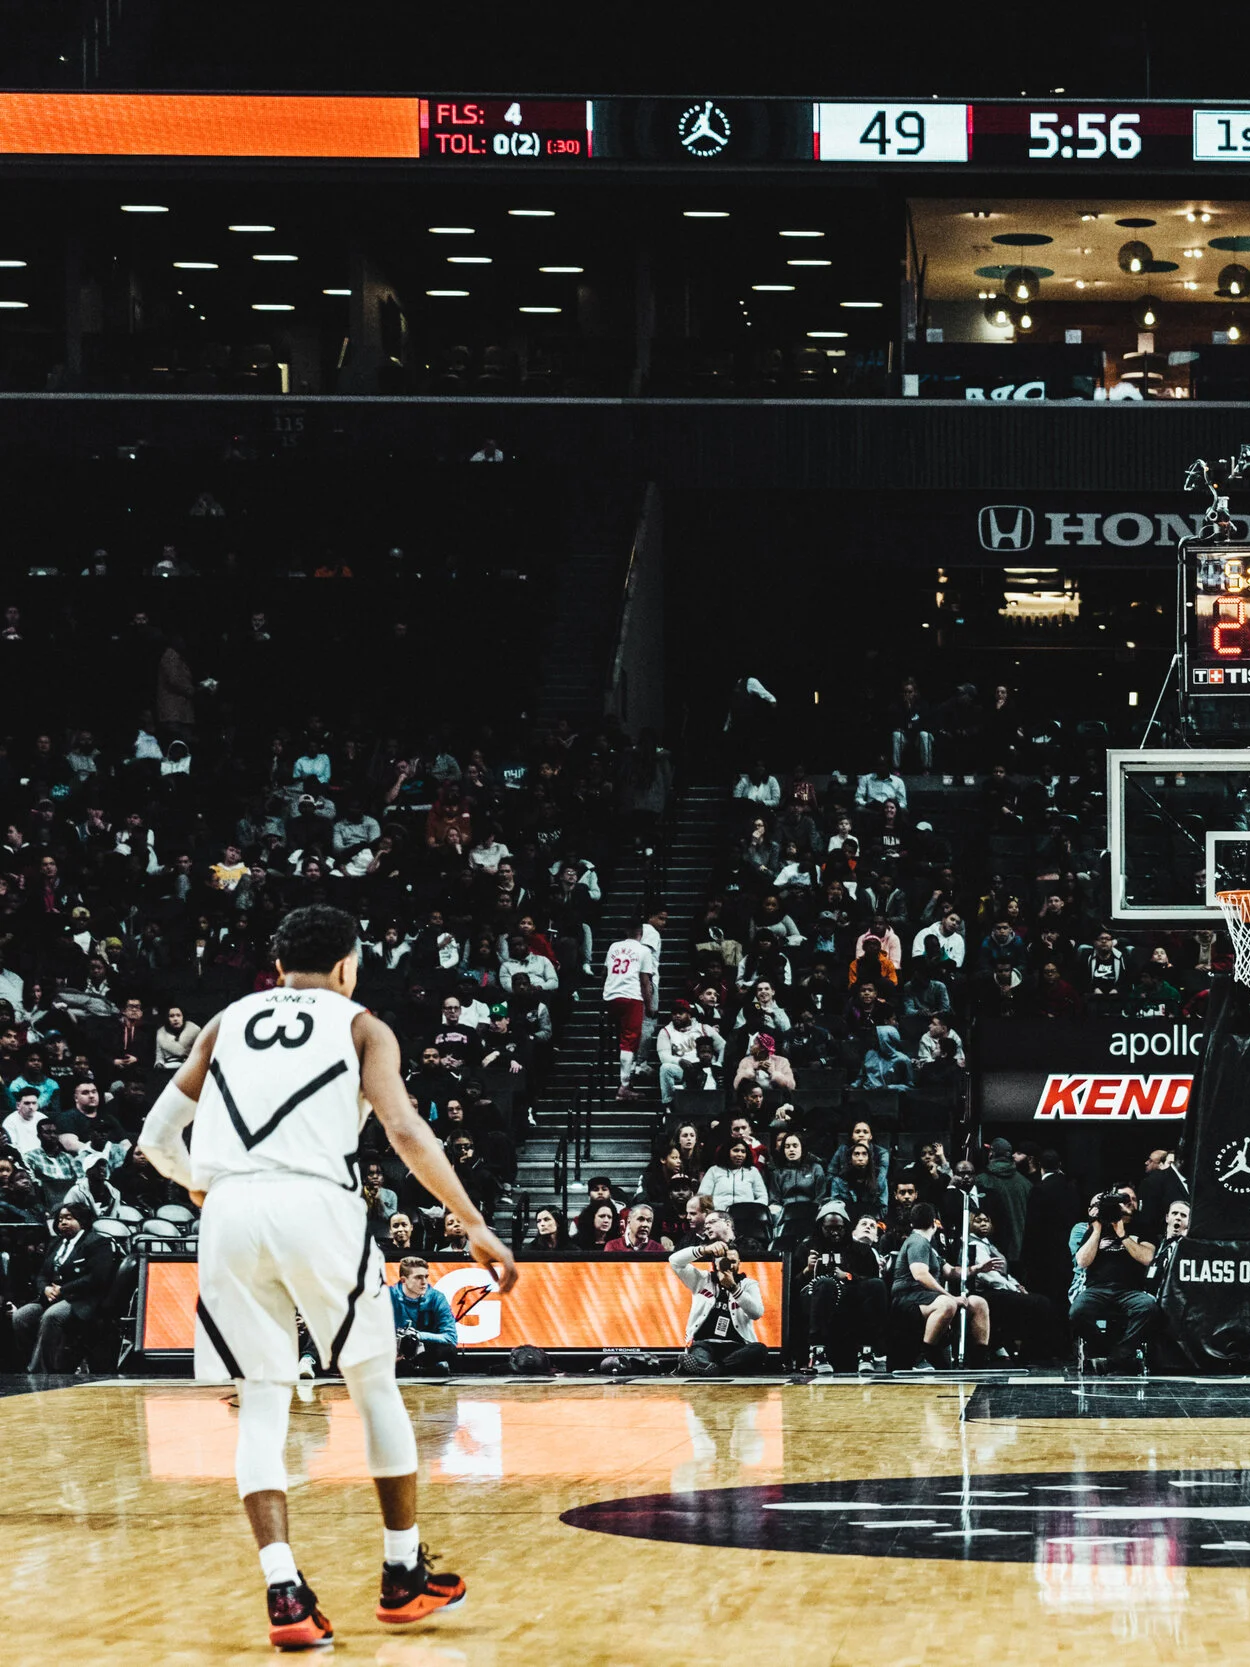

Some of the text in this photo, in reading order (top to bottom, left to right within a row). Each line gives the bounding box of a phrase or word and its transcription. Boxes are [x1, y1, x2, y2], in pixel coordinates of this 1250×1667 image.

[437, 103, 522, 125] FLS: 4
[435, 133, 486, 154] TOL:
[547, 140, 580, 155] (:30)
[859, 110, 925, 156] 49
[1029, 113, 1142, 159] 5:56
[612, 958, 631, 975] 23
[265, 995, 317, 1005] JONES
[244, 1008, 314, 1051] 3
[1034, 1073, 1194, 1120] KEND
[1215, 1141, 1237, 1172] JORDAN
[1179, 1259, 1235, 1284] CLASS
[435, 1267, 501, 1345] G
